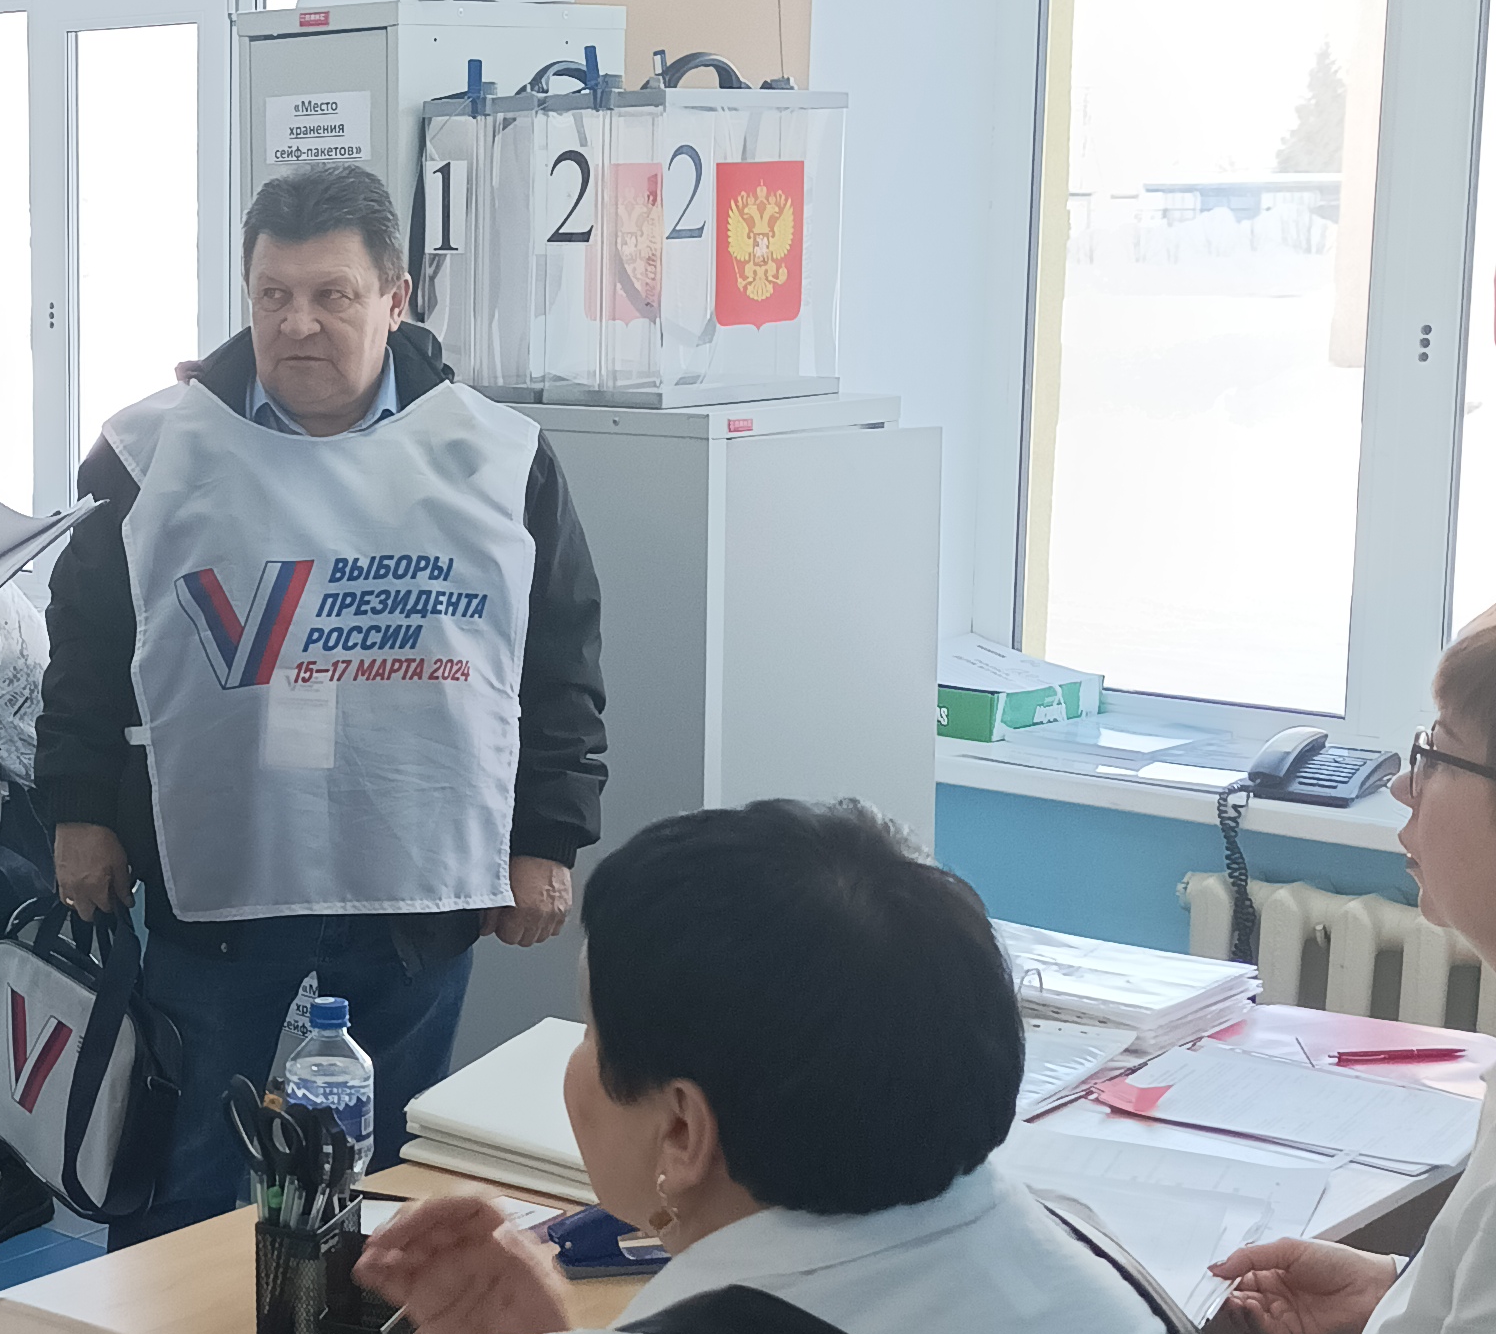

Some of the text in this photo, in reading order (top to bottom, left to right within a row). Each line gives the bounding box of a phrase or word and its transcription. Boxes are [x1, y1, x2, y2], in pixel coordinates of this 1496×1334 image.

[294, 100, 338, 113] «Место
[289, 124, 345, 137] хранения
[274, 146, 362, 161] сейф-пакетов»
[432, 161, 459, 252] 1
[546, 149, 594, 243] 2
[666, 144, 706, 240] 2
[328, 554, 454, 584] ВЫБОРЫ
[315, 589, 489, 619] ПРЕЗИДЕНТА
[302, 624, 424, 653] РОССИИ
[353, 658, 425, 683] МАРТА
[427, 658, 471, 682] 2024
